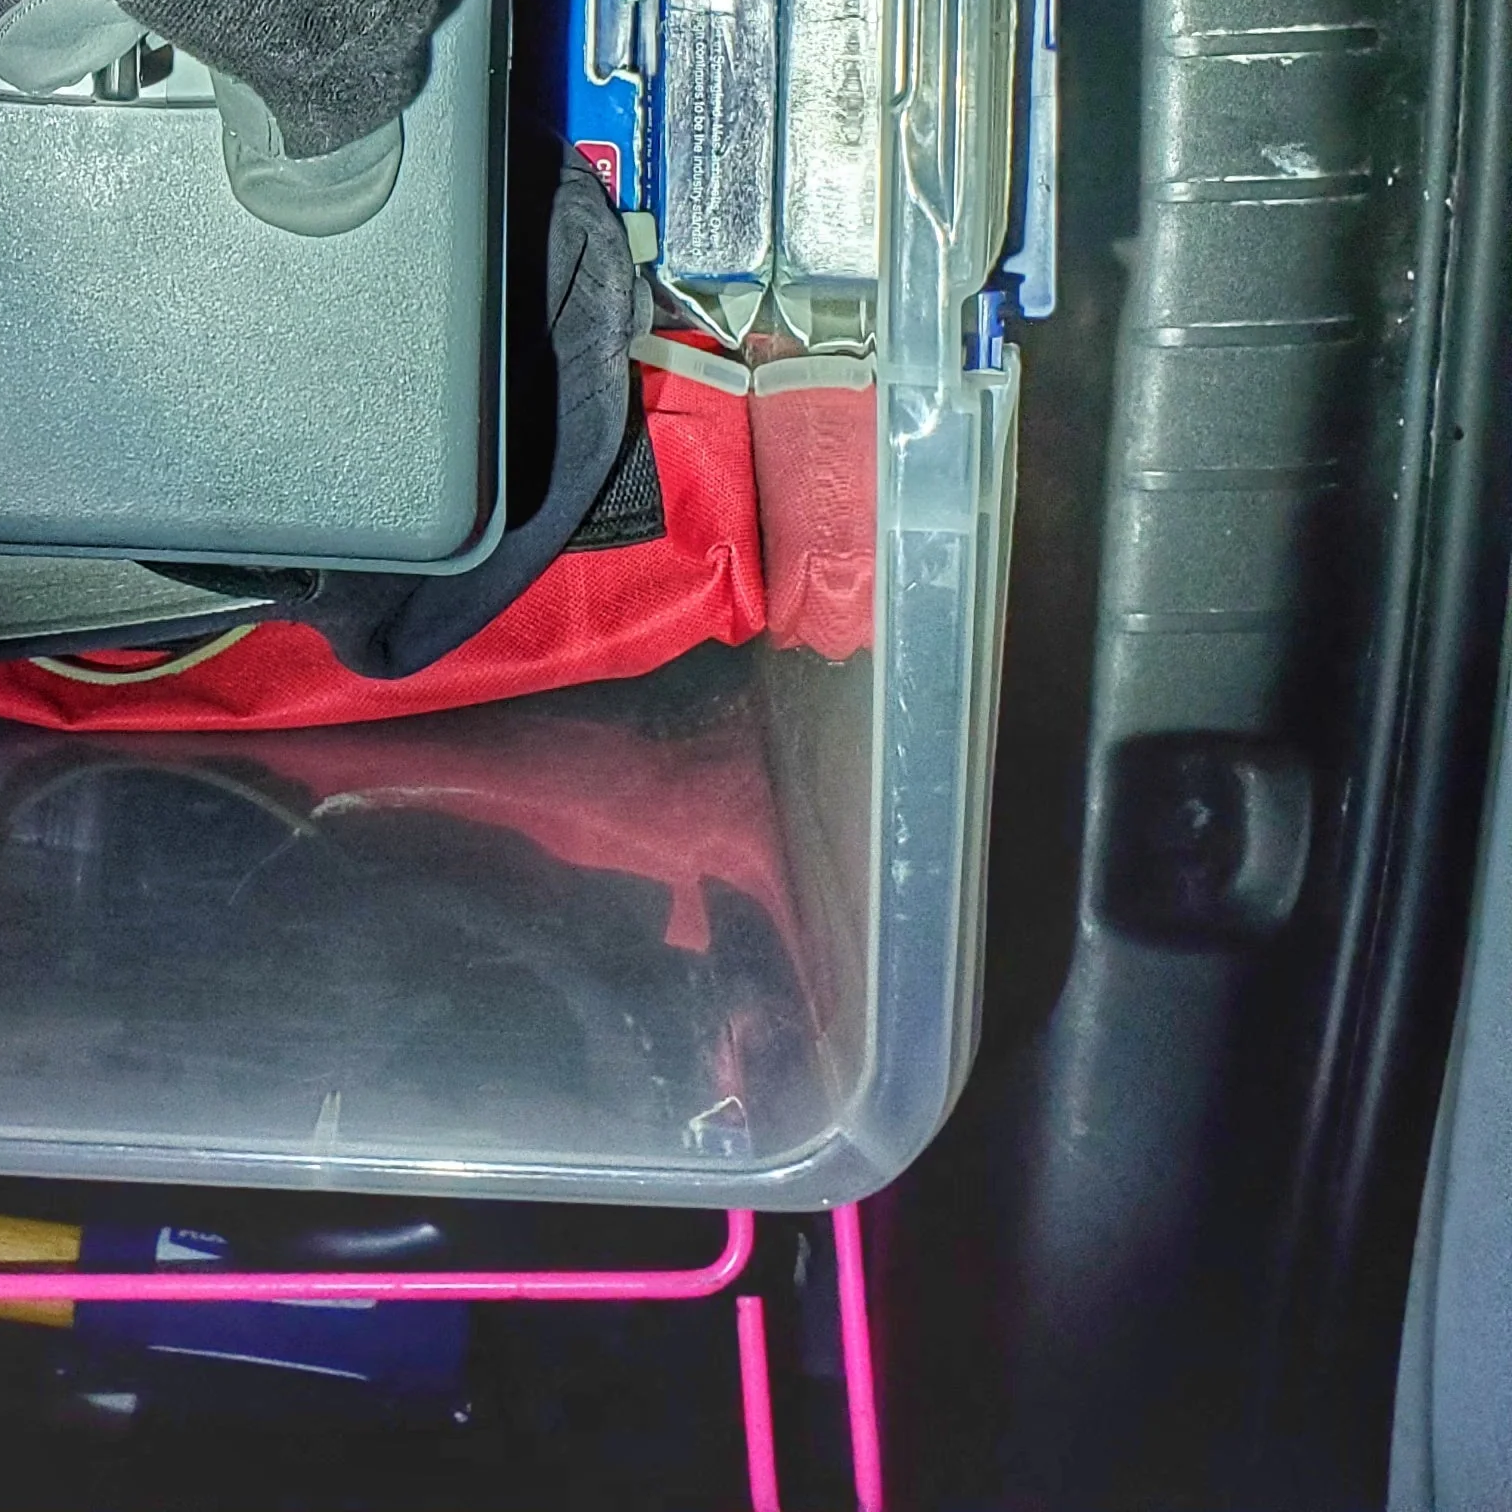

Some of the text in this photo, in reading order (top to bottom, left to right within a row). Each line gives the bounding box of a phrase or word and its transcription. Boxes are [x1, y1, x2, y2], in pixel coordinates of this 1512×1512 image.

[693, 42, 706, 99] continues
[693, 101, 705, 113] to
[693, 116, 705, 132] be
[693, 134, 705, 152] the
[690, 155, 704, 202] industry
